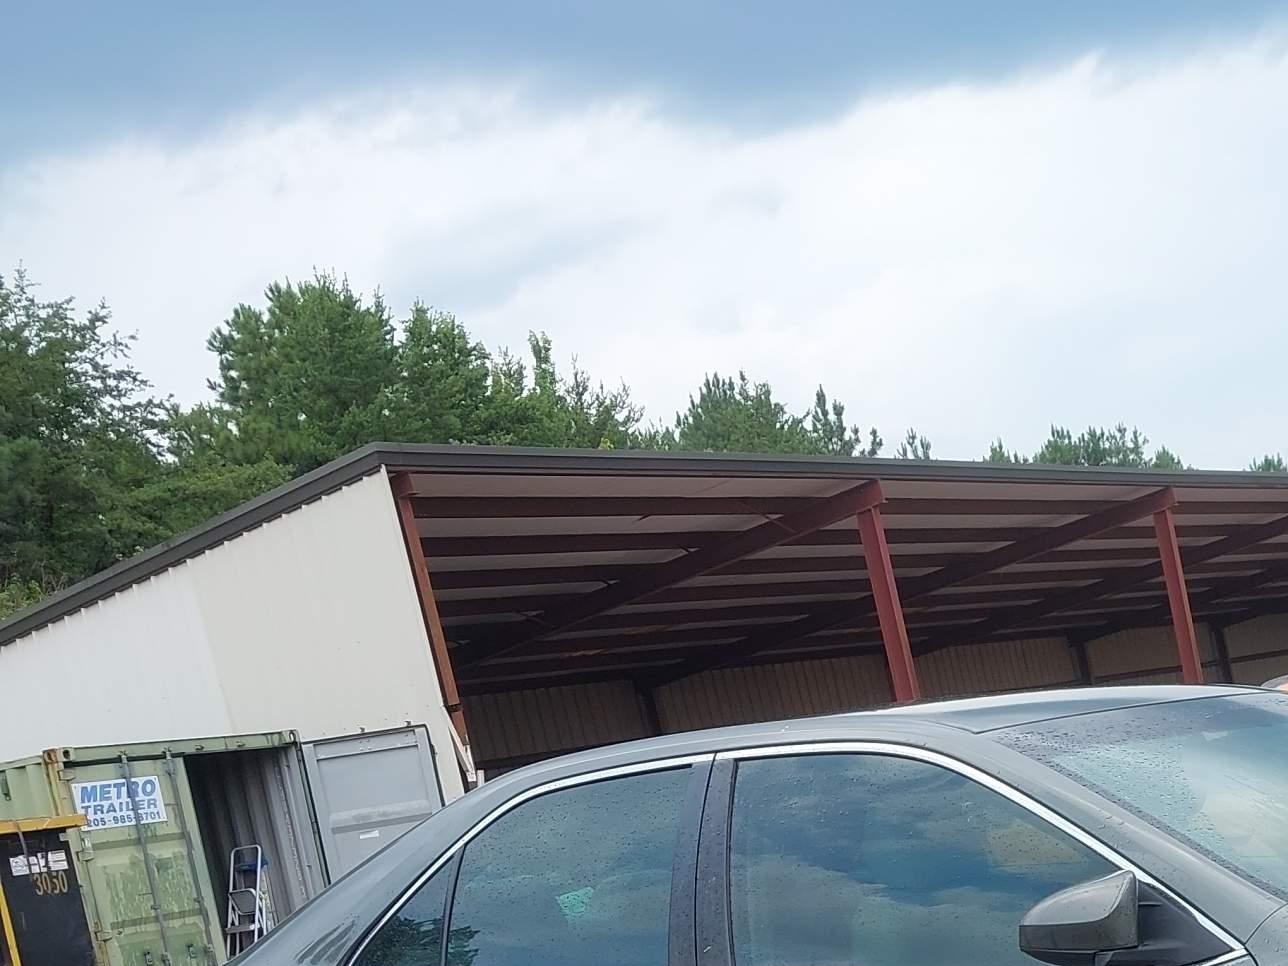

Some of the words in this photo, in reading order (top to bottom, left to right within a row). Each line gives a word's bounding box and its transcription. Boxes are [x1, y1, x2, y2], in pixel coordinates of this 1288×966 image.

[80, 779, 156, 804] METRO
[81, 798, 158, 815] TRAILER
[32, 871, 68, 896] 3050
